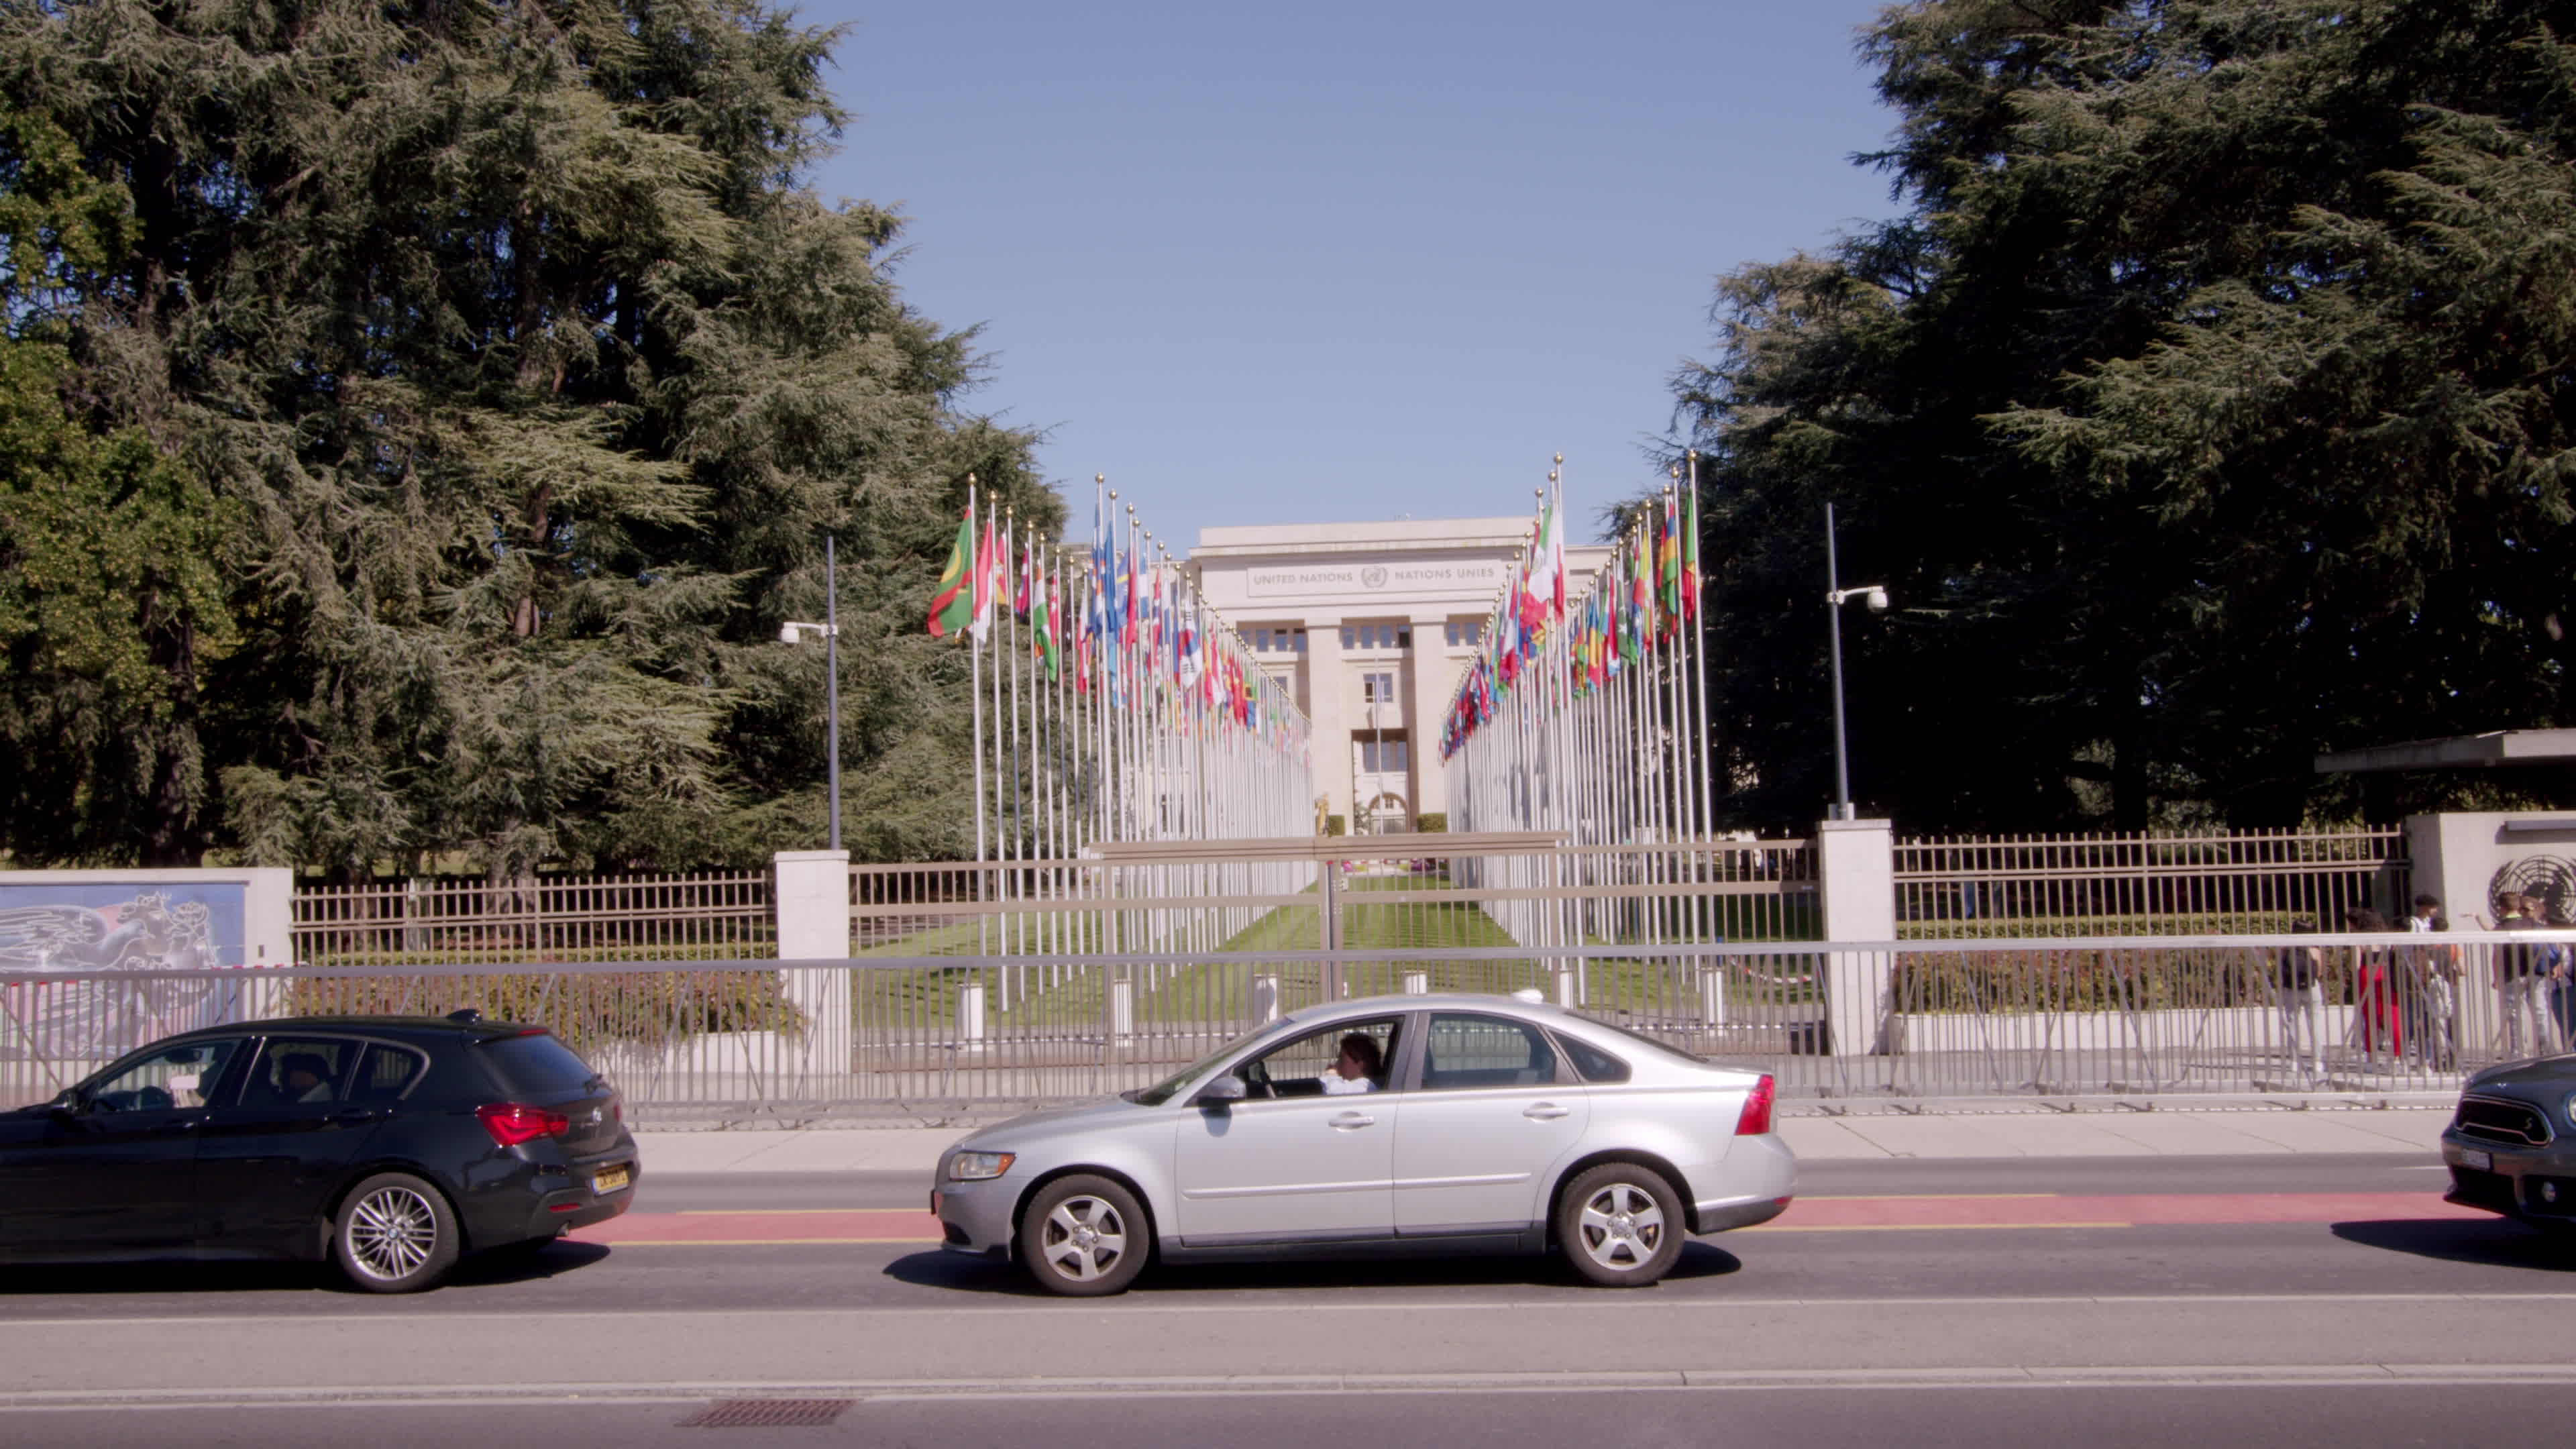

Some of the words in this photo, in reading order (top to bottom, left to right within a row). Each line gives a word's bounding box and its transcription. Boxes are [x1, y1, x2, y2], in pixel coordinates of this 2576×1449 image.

[1253, 574, 1295, 585] UNITED
[1299, 572, 1352, 582] NATIONS
[1394, 568, 1452, 580] NATIONS
[1456, 567, 1494, 578] UNIES
